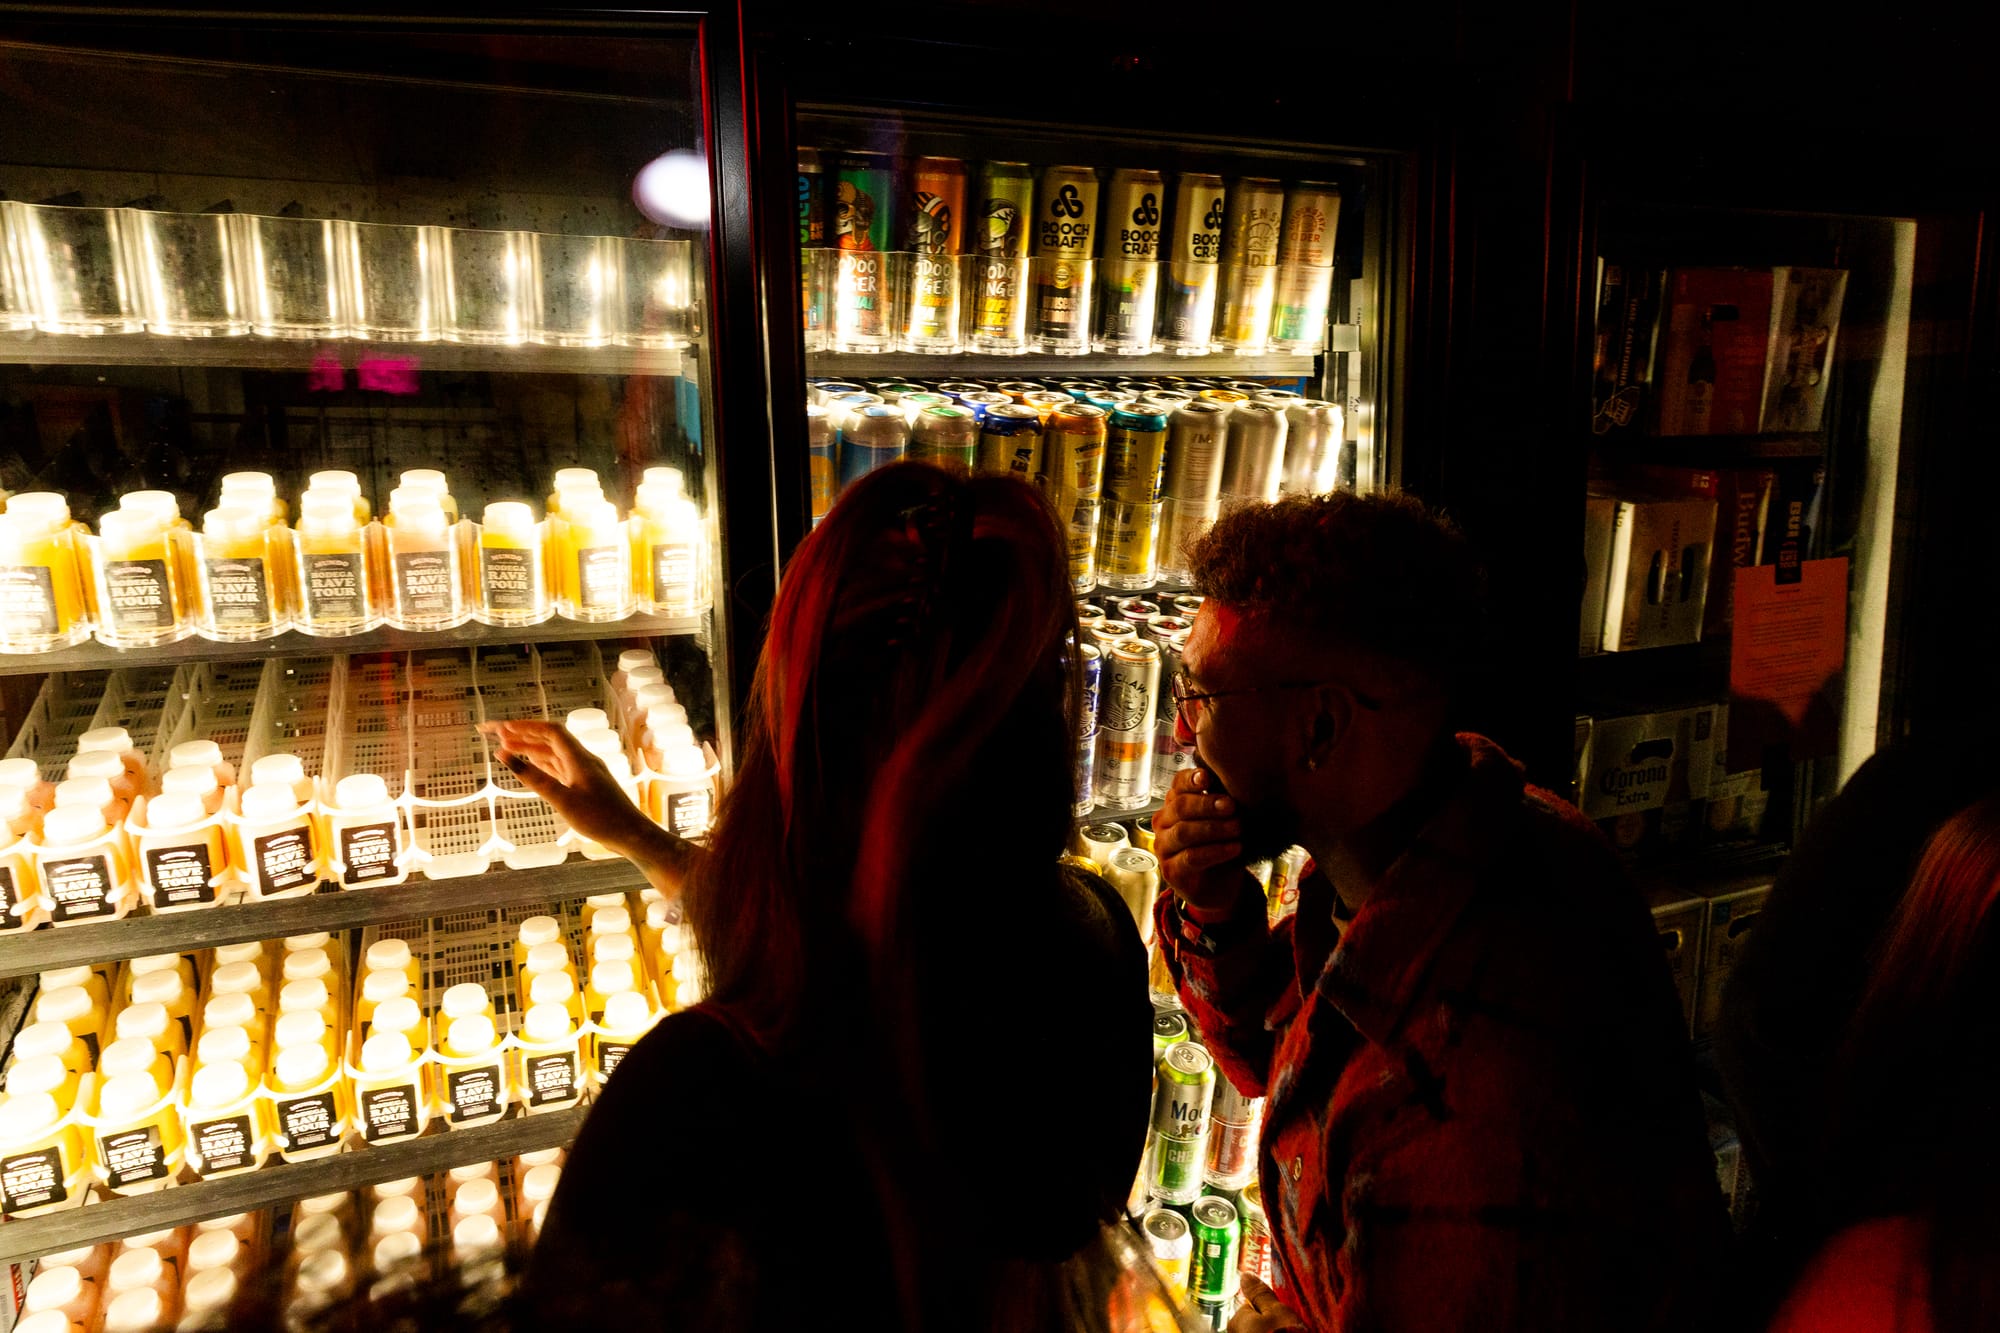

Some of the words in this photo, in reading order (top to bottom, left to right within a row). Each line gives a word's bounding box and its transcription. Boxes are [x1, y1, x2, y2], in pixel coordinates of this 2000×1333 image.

[1042, 223, 1091, 236] BOOCH
[1042, 236, 1088, 250] CRAFT
[1121, 230, 1161, 243] BOOC
[1290, 232, 1321, 243] CDER
[1733, 492, 1757, 568] Budw
[406, 575, 449, 586] RAVE
[488, 571, 528, 581] RAVE
[212, 583, 258, 593] RAVE
[312, 578, 356, 588] RAVE
[488, 580, 529, 590] TOUR
[110, 585, 161, 597] RAVE
[312, 587, 357, 597] TOUR
[408, 585, 450, 595] TOUR
[112, 596, 163, 607] TOUR
[213, 593, 260, 602] TOUR
[1601, 765, 1667, 795] Corona
[1615, 790, 1650, 806] Extra
[349, 852, 391, 866] TOUR
[157, 867, 204, 880] RAVE
[159, 876, 205, 889] TOUR
[535, 1069, 572, 1082] RAVE
[535, 1077, 572, 1090] TOUR
[456, 1085, 495, 1099] RAVE
[456, 1093, 494, 1106] TOUR
[370, 1104, 410, 1118] RAVE
[370, 1112, 411, 1125] TOUR
